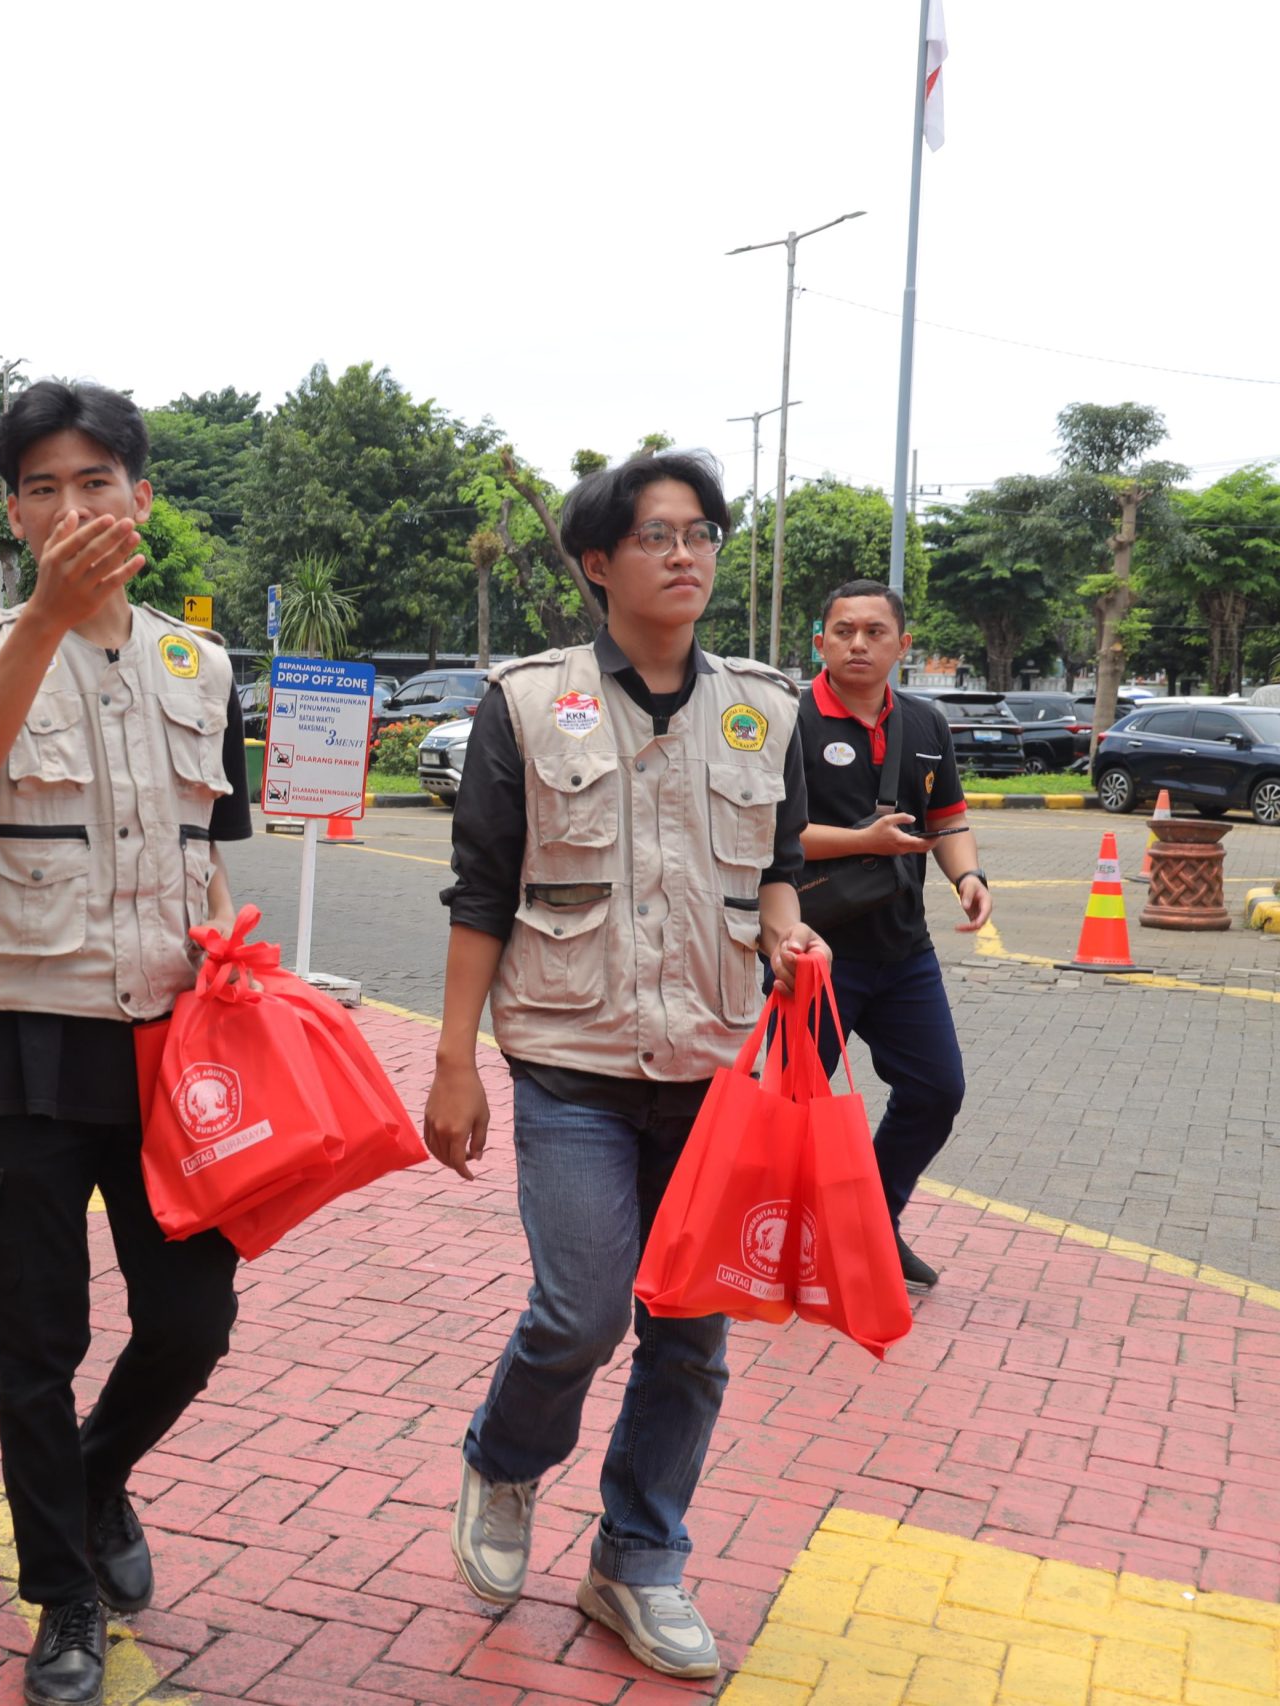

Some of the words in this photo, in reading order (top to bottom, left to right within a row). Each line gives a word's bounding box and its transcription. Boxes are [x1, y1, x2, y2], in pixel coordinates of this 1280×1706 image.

[278, 662, 322, 673] SEPANJANG
[322, 666, 346, 675] JALUR
[277, 671, 309, 684] DROP
[311, 674, 334, 686] OFF
[336, 677, 368, 689] ZONE
[300, 694, 319, 702] ZONA
[320, 696, 367, 706] MENURUNKAN
[299, 704, 341, 713] PENUMPANG
[298, 714, 316, 722] BATAS
[316, 716, 335, 724] WAKTU
[566, 712, 586, 720] KKN
[298, 723, 327, 733] MAKSIMAL
[325, 729, 337, 746] 3
[334, 738, 366, 748] MENIT
[296, 754, 333, 765] DILARANG
[334, 759, 360, 767] PARKIR
[292, 786, 319, 794] DILARANG
[186, 1149, 215, 1171] UNTAG
[721, 1270, 750, 1289] UNTAG
